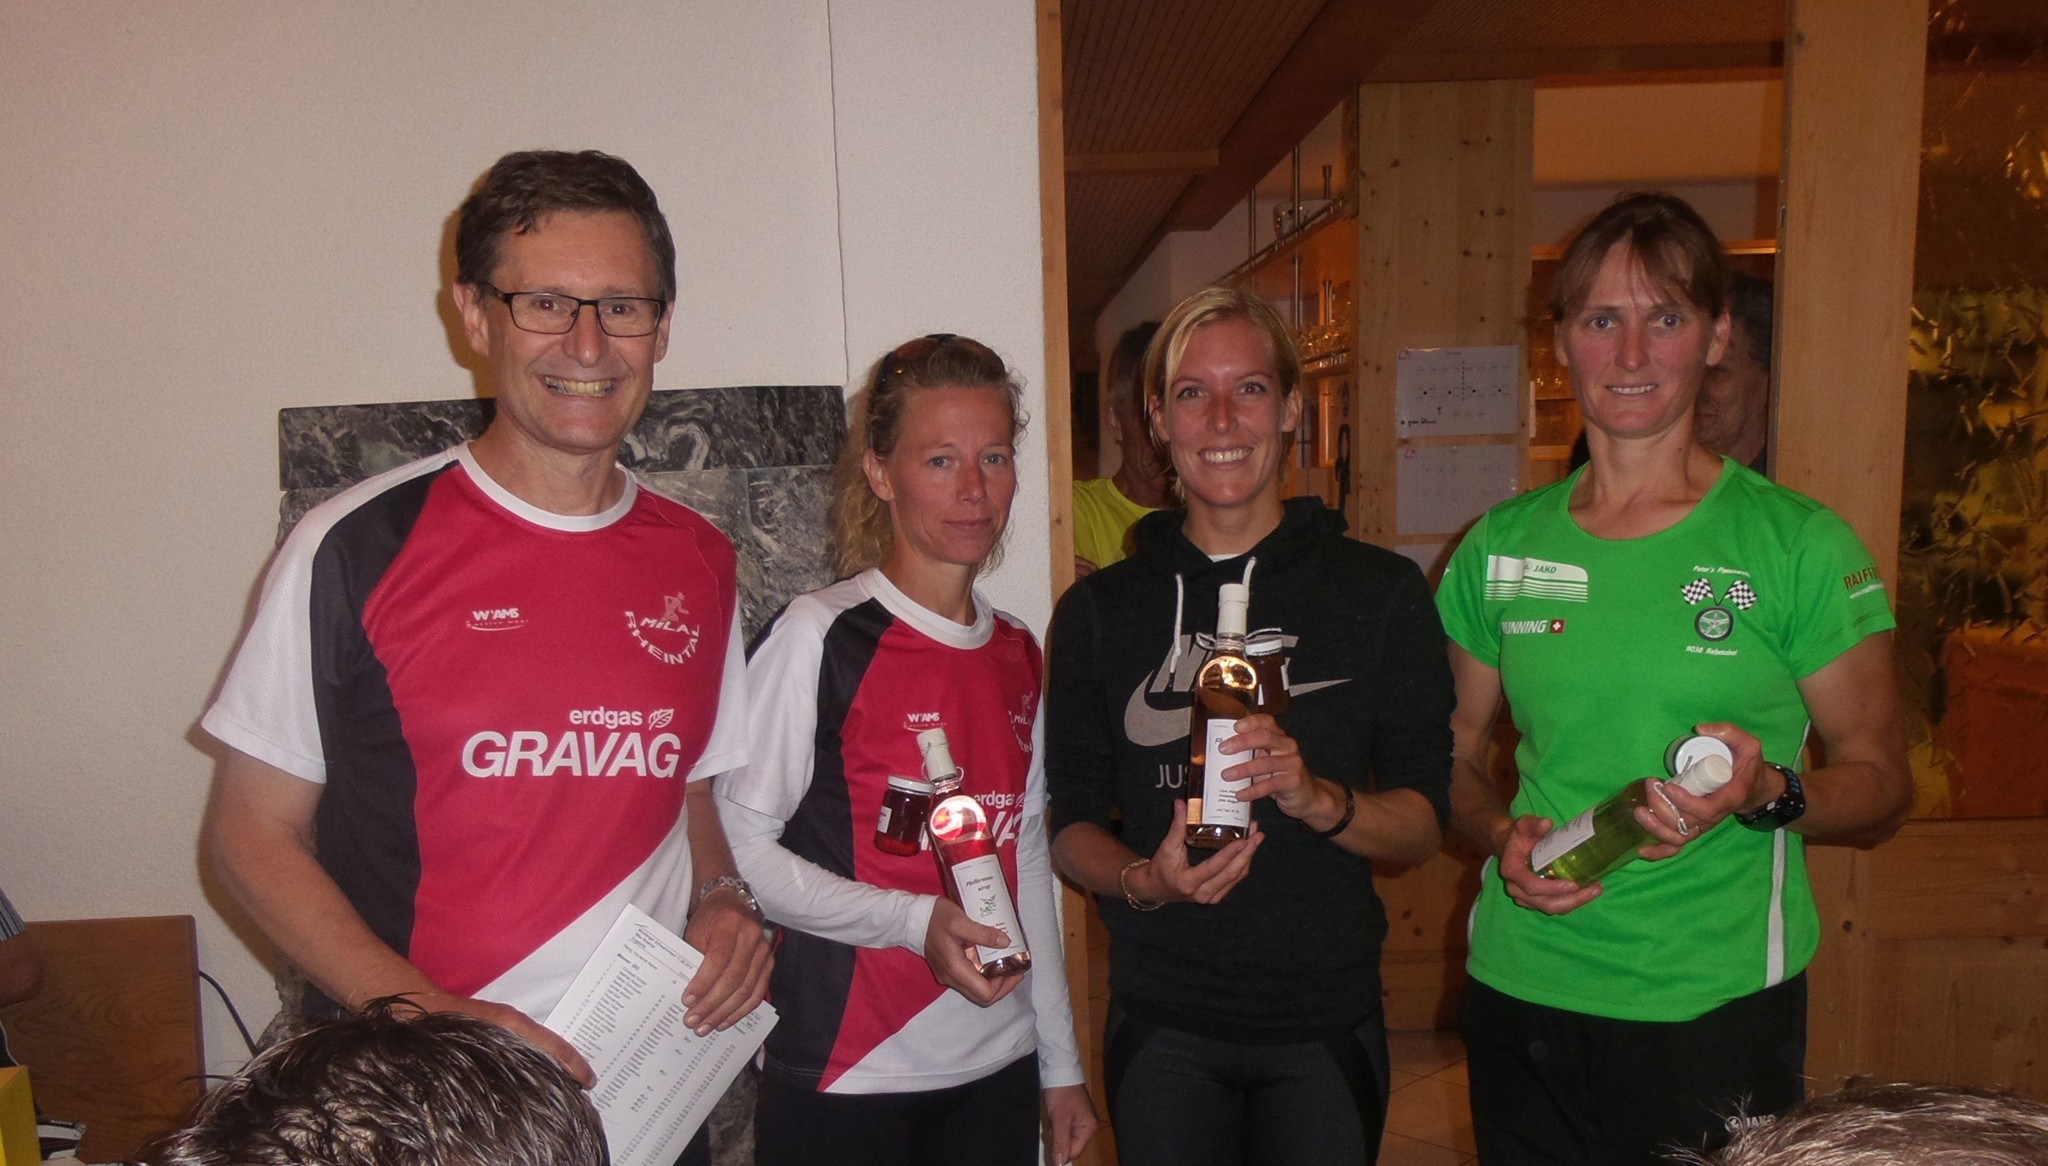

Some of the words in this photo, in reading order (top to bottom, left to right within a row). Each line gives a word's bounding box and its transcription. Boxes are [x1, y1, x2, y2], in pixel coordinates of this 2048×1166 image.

[1533, 564, 1557, 574] JAKO
[568, 705, 643, 730] erdgas
[461, 730, 682, 779] GRAVAG
